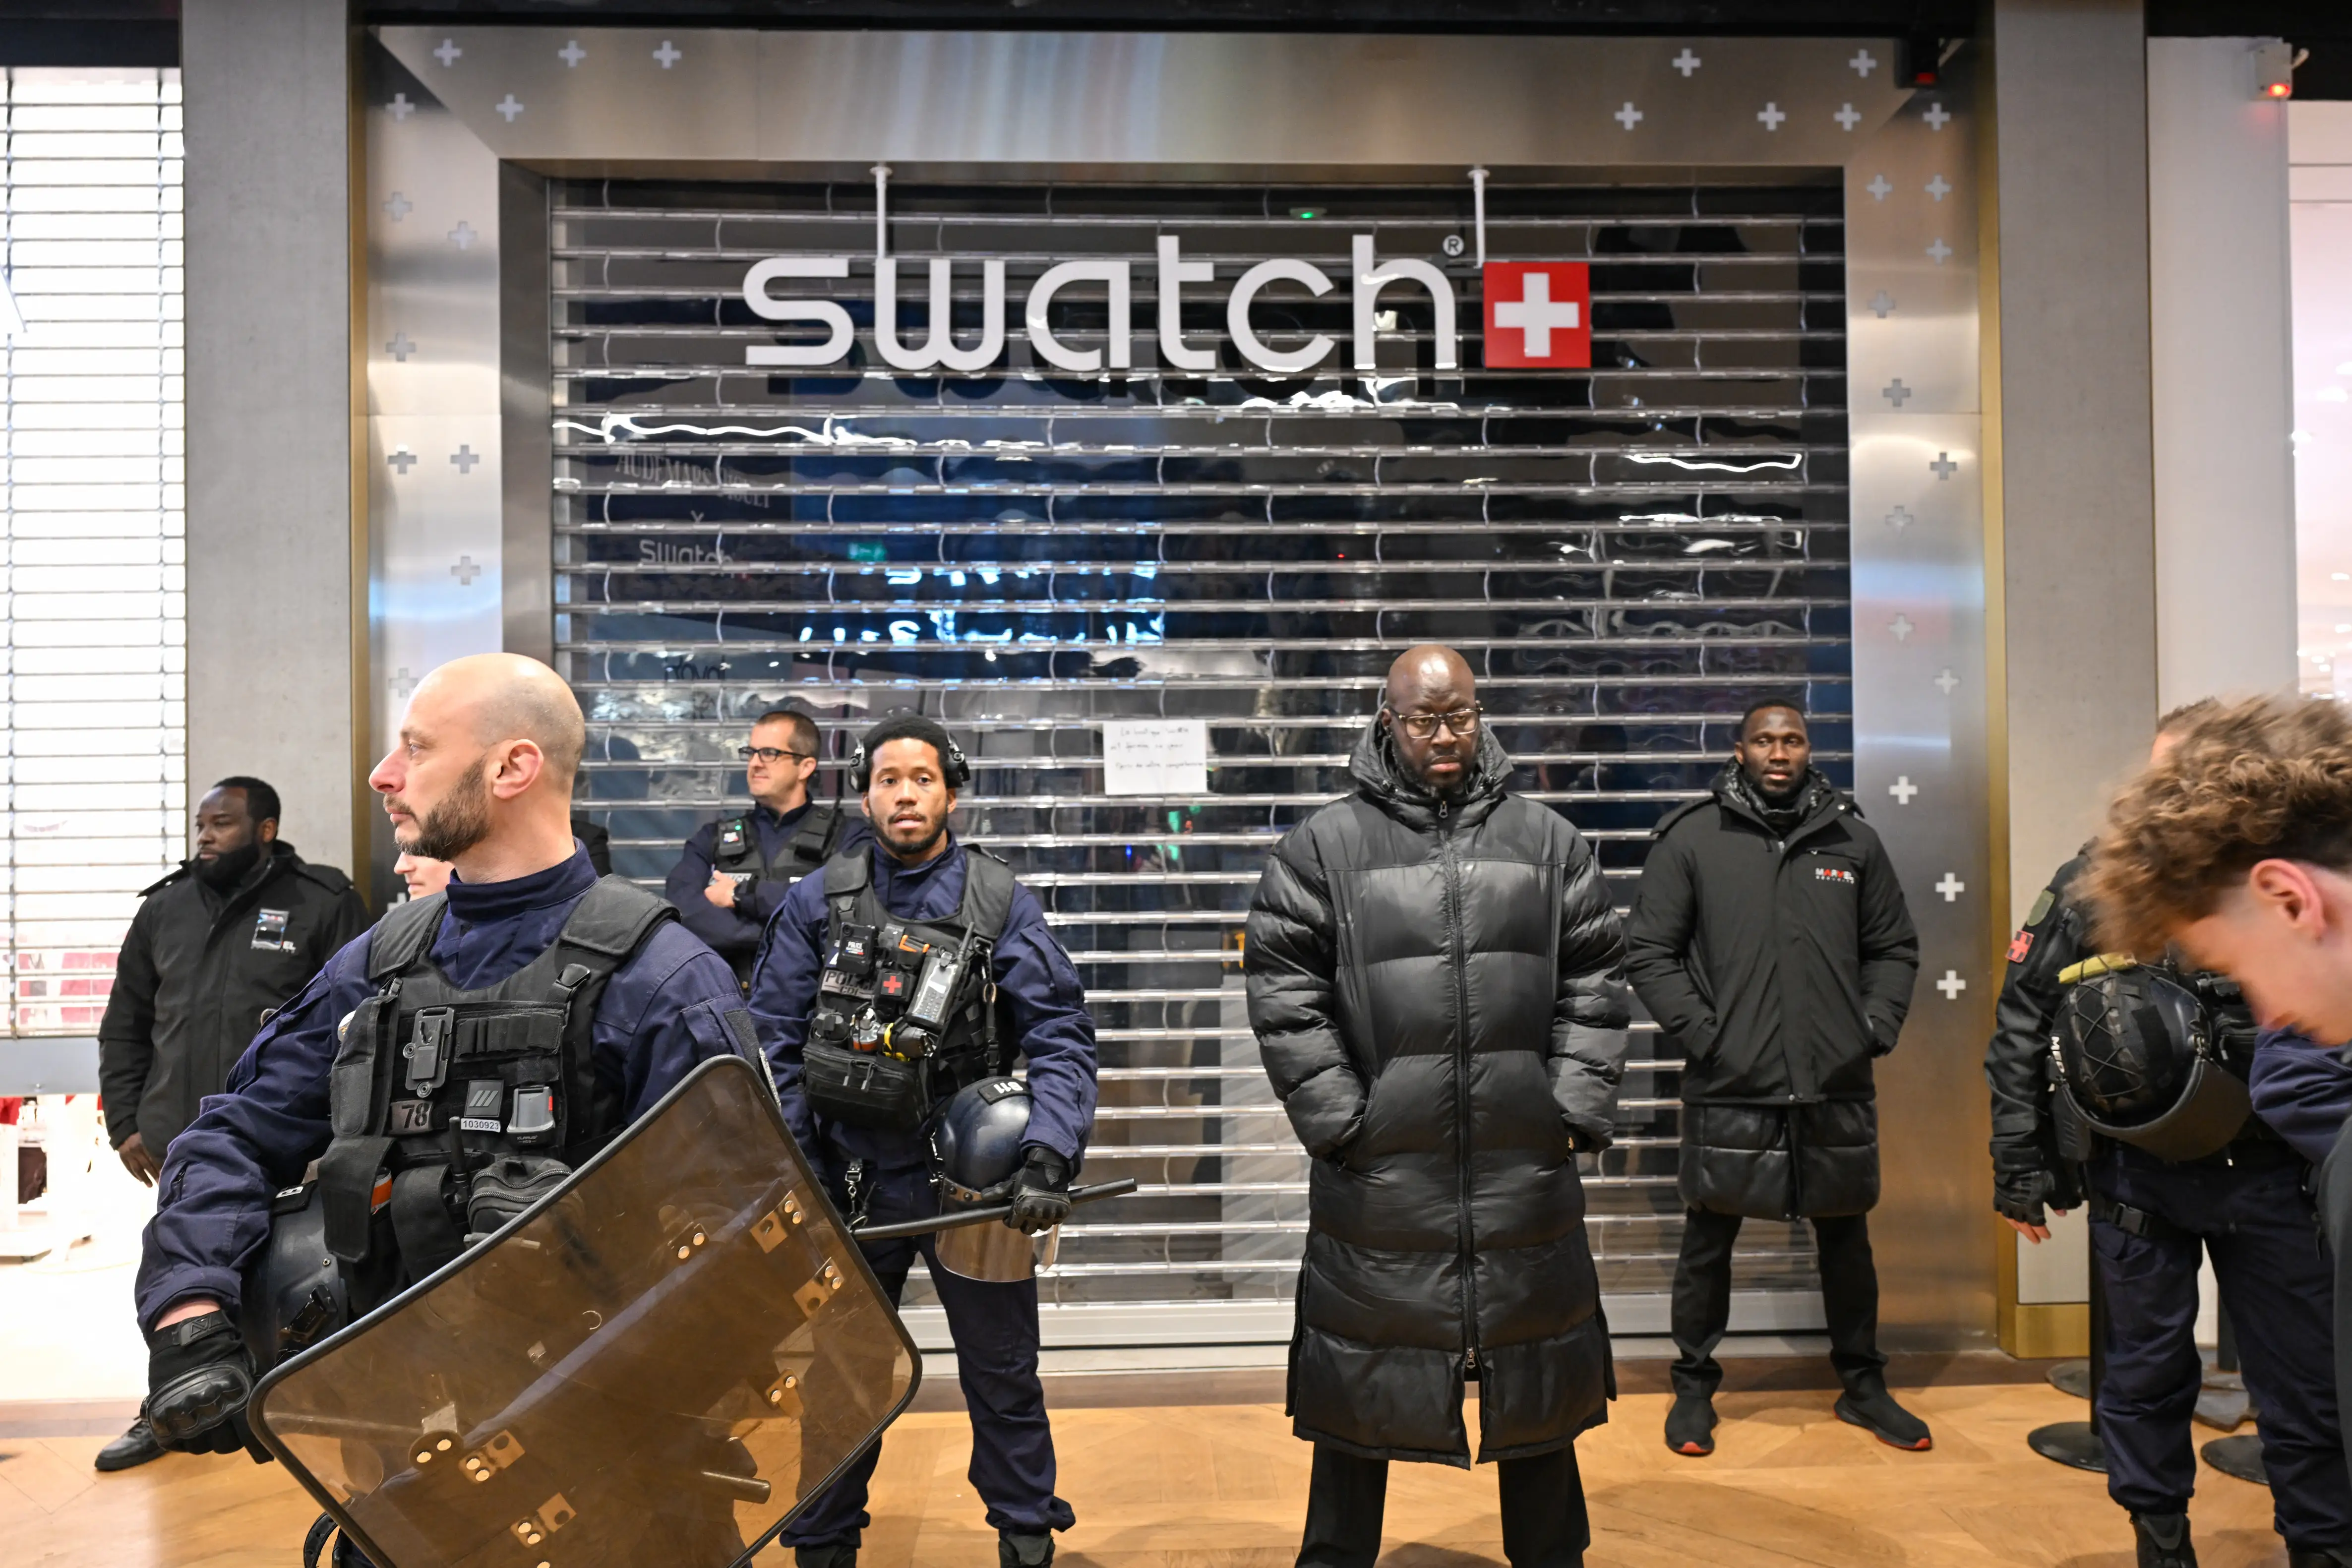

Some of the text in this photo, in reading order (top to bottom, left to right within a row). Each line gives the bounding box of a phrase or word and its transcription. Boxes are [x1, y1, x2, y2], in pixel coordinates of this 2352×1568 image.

[742, 235, 1455, 371] swatch
[402, 1102, 430, 1129] 78
[463, 1120, 499, 1130] 1030923
